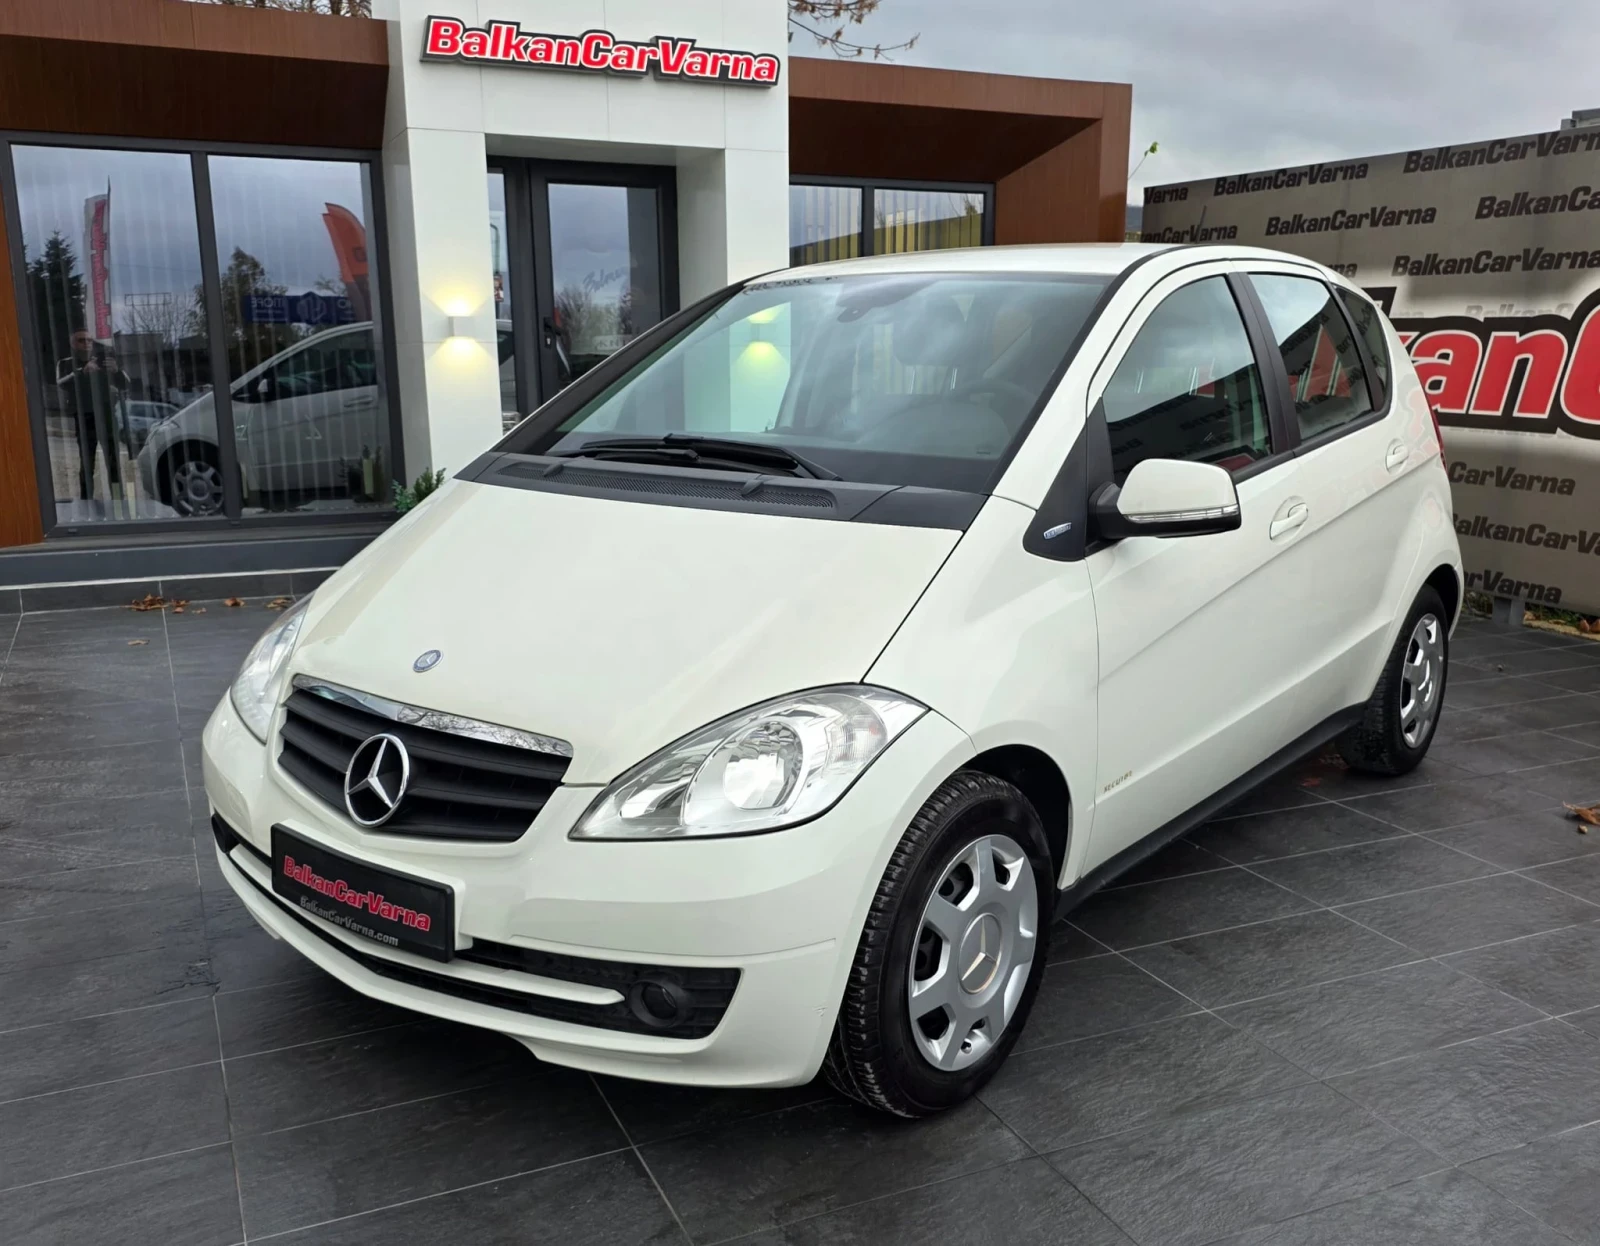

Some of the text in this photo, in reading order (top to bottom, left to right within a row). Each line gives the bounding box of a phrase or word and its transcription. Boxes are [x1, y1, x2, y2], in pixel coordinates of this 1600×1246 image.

[426, 18, 778, 82] BalkanCarVarna
[1213, 162, 1369, 196] BalkanCarVarna
[1265, 205, 1437, 236] BalkanCarVarna
[1391, 247, 1600, 276] BalkanCarVarna
[1453, 513, 1600, 556] alkanCarV
[284, 855, 431, 931] BalkanCarVarna
[300, 895, 399, 946] BalkanCarVarna.com
